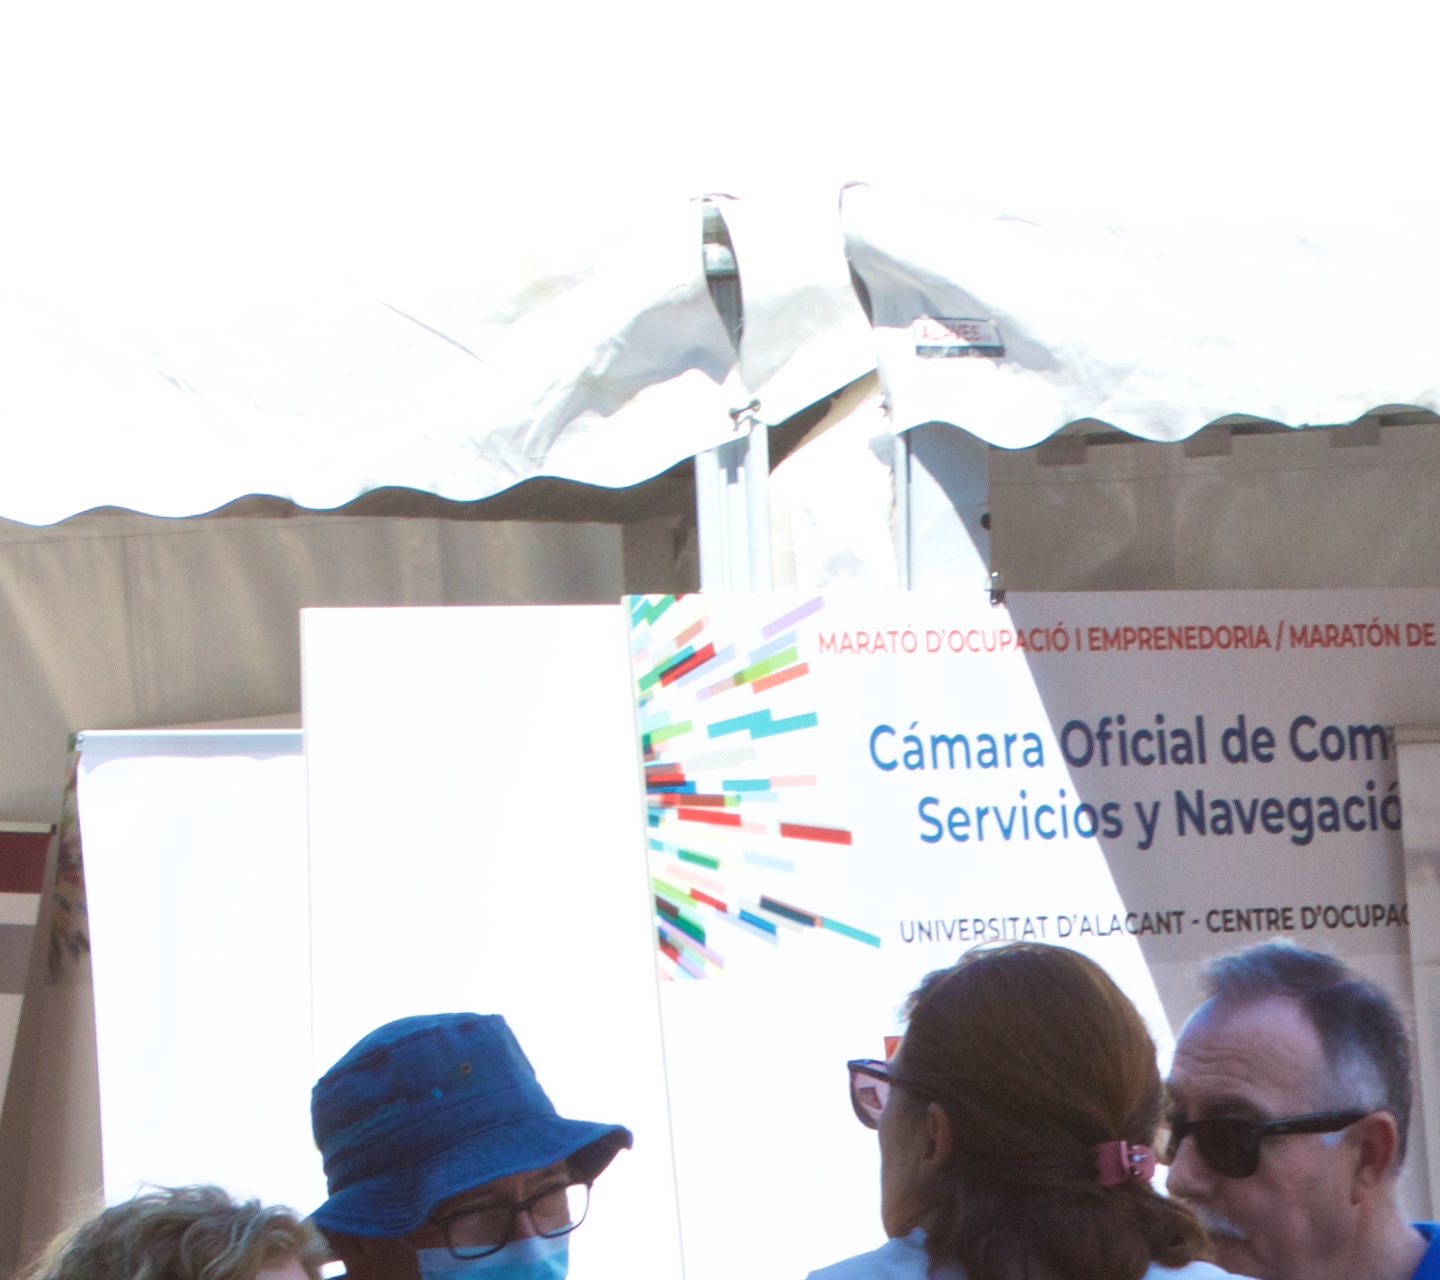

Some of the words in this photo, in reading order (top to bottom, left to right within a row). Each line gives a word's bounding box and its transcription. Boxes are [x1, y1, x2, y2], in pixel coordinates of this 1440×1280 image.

[818, 624, 918, 655] MARATÓ
[926, 622, 1068, 653] D'OCUPACIÓ
[1088, 624, 1271, 651] EMPRENEDORIA
[1290, 617, 1400, 648] MARATÓN
[1407, 624, 1437, 647] DE
[869, 720, 1046, 772] Cámara
[1062, 713, 1207, 768] Oficial
[1221, 713, 1276, 763] de
[918, 789, 1123, 845] Servicios
[1136, 802, 1161, 849] y
[1176, 780, 1402, 845] Navegació
[900, 915, 1049, 944] UNIVERSITAT
[1058, 910, 1184, 938] D'ALACANT
[1207, 908, 1293, 934] CENTRE
